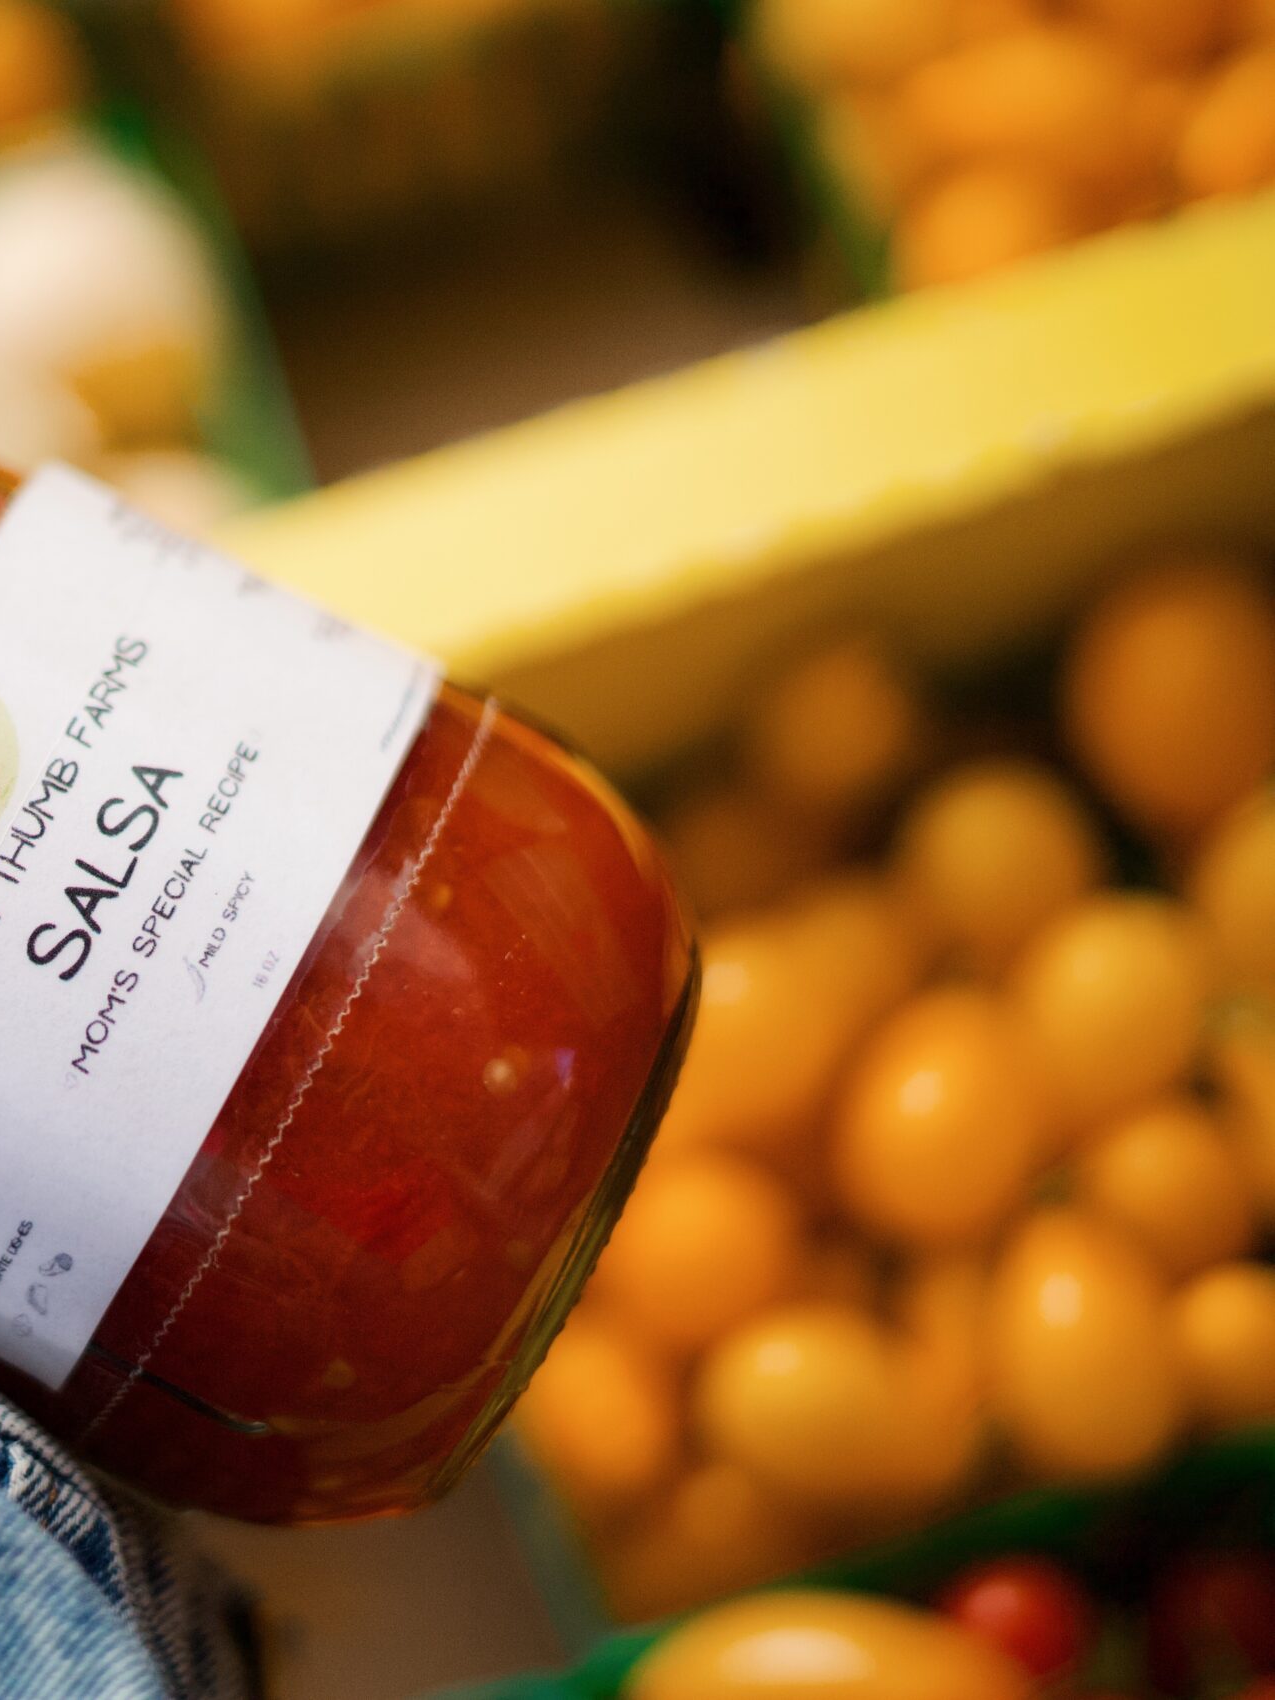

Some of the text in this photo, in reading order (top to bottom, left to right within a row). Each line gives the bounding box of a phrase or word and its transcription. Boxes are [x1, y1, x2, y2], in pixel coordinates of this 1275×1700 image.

[65, 636, 148, 748] FARMS
[26, 762, 184, 981] SALSA
[70, 741, 261, 1075] MOM'S SPECIAL RECIPE
[199, 871, 255, 968] MILD SPICY
